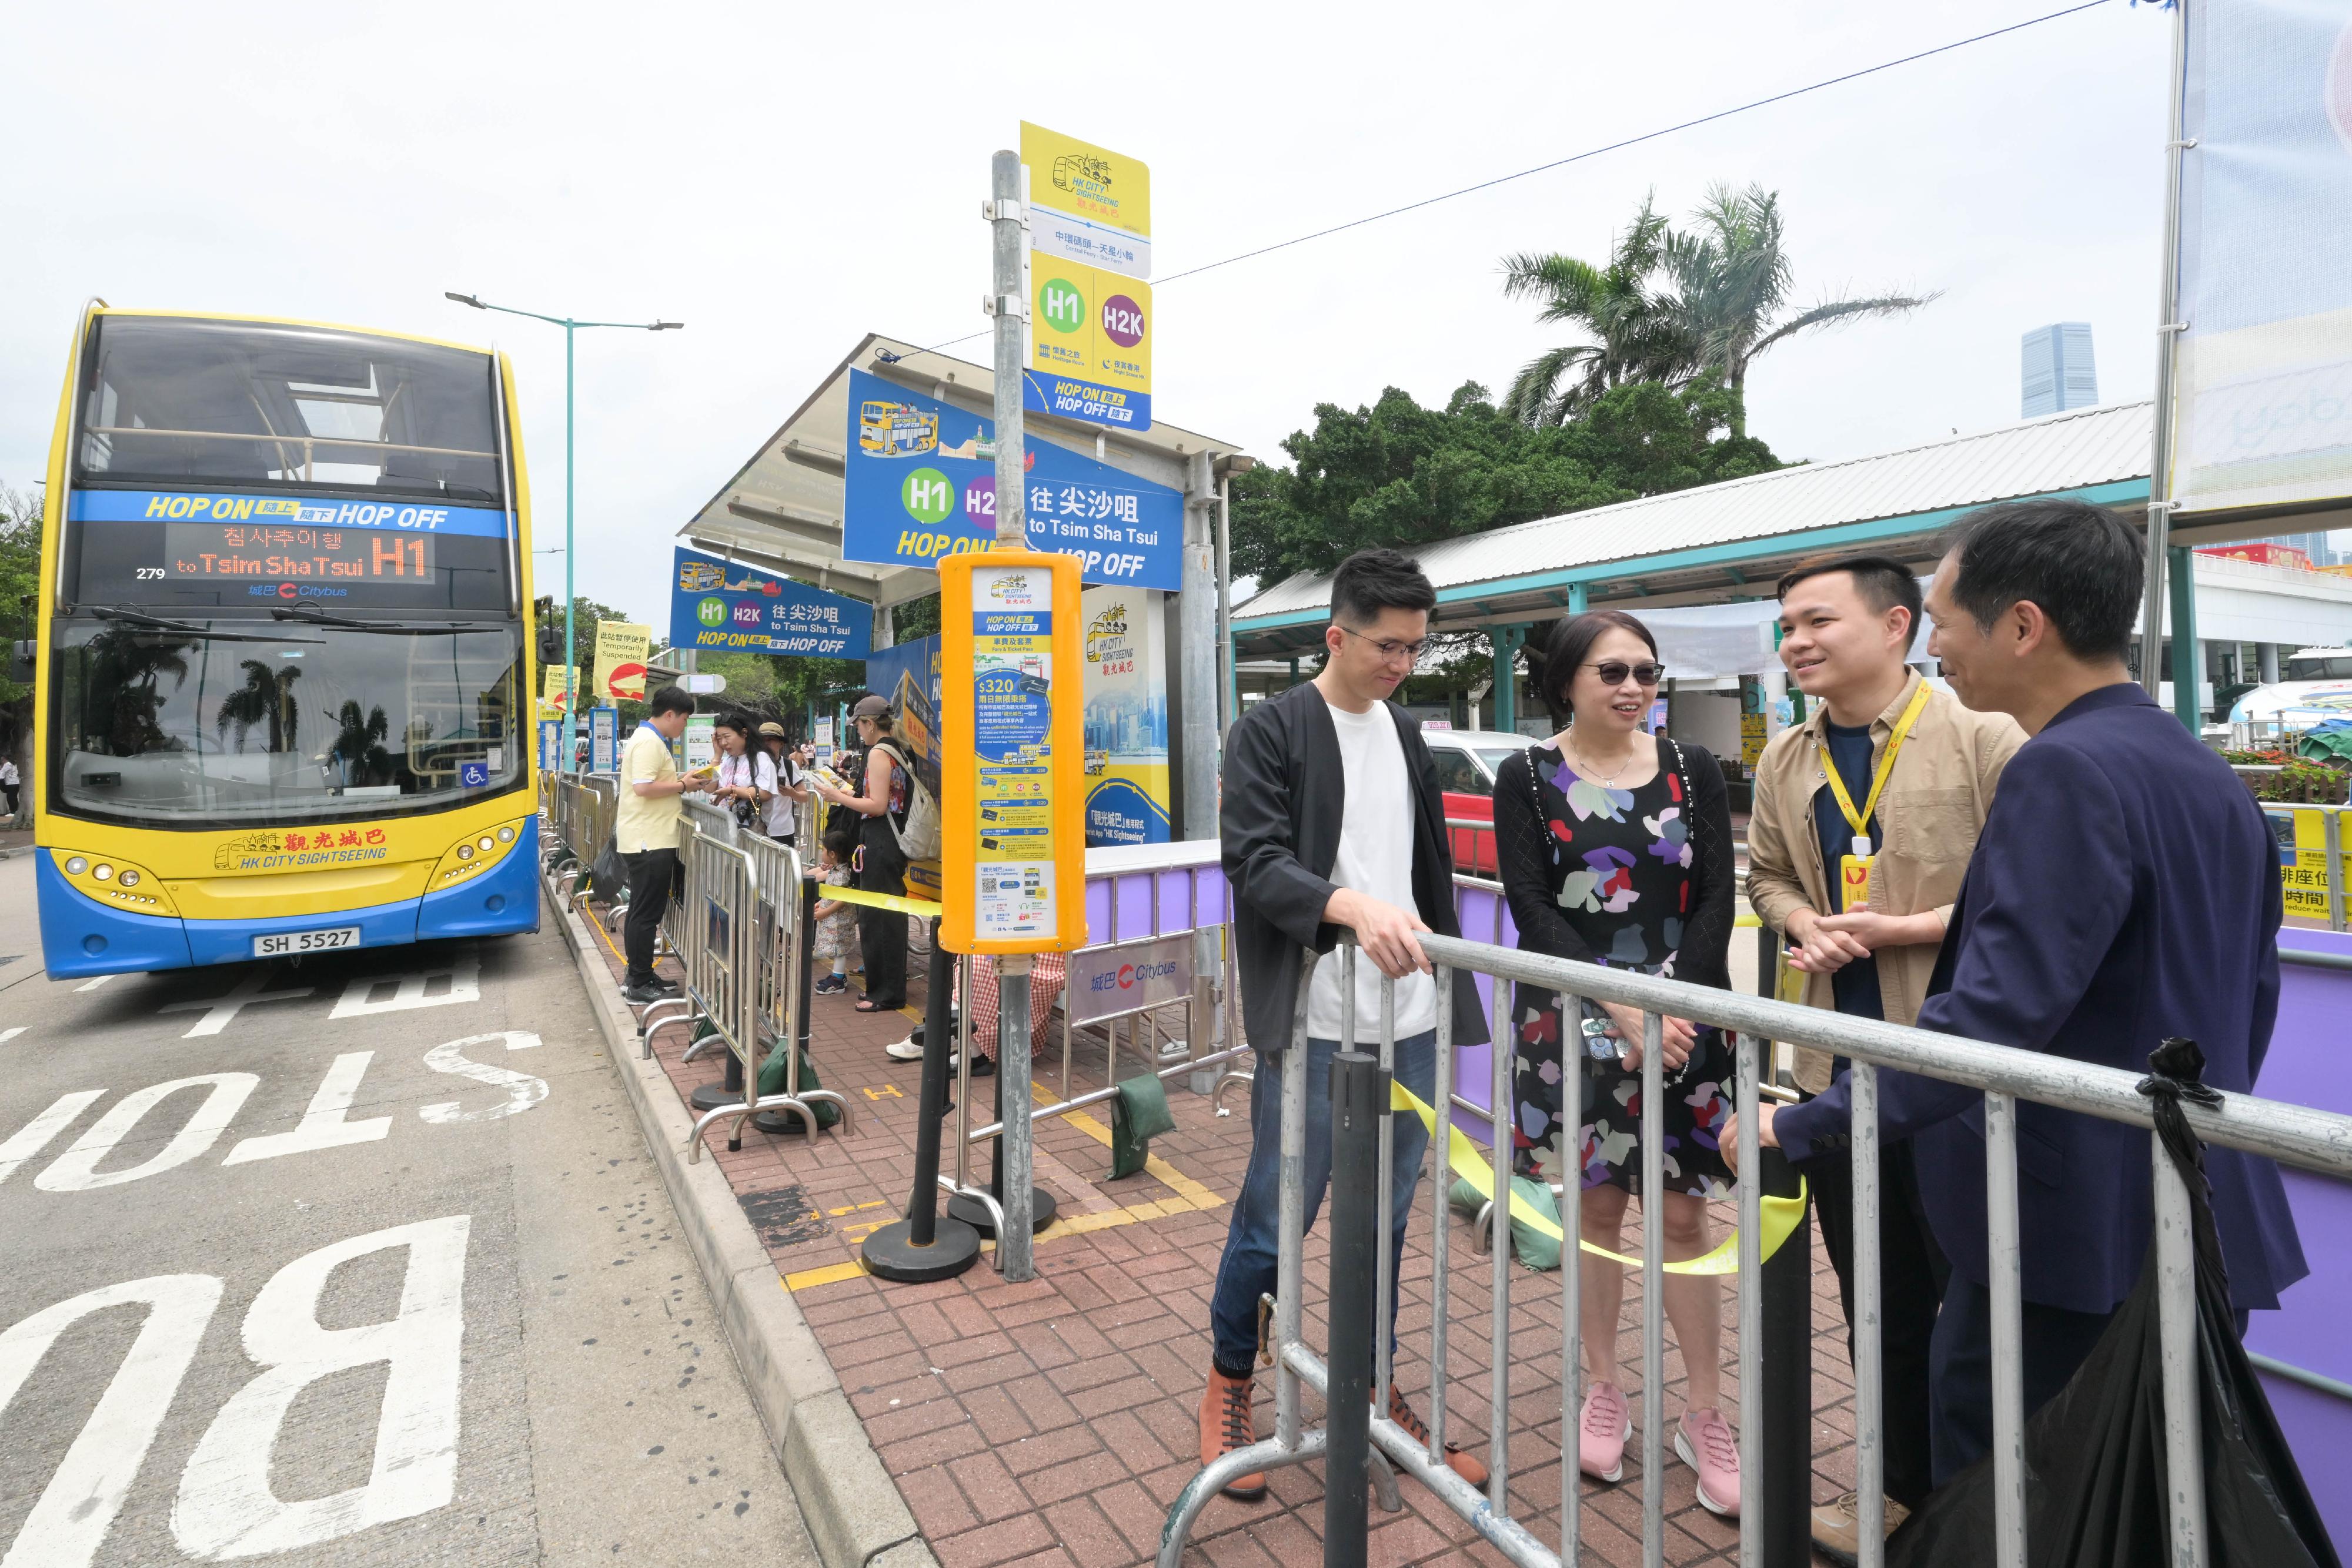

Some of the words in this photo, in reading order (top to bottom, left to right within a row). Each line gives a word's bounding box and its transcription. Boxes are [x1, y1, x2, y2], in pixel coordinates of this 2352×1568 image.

[1073, 177, 1085, 188] HK
[1085, 180, 1105, 193] CITY
[1076, 188, 1119, 208] SIGHTSEEING
[1065, 245, 1083, 254] Central
[1084, 249, 1096, 259] Ferry
[1110, 258, 1122, 266] Ferry
[1047, 287, 1078, 323] H1
[1104, 306, 1143, 337] H2K
[1053, 355, 1071, 363] Heritage
[1055, 381, 1081, 397] HOP
[1082, 387, 1100, 402] ON
[1055, 396, 1083, 412] HOP
[1084, 402, 1107, 416] OFF
[910, 478, 946, 511] H1
[966, 489, 995, 515] H2
[1031, 486, 1053, 513] 往
[1060, 487, 1139, 523] 尖沙咀
[145, 497, 211, 518] HOP
[212, 499, 255, 519] ON
[262, 502, 292, 514] 隨上
[299, 509, 331, 520] 隨下
[336, 504, 395, 526] HOP
[397, 508, 448, 529] OFF
[1030, 519, 1045, 533] to
[1050, 519, 1088, 538] Tsim
[1094, 524, 1122, 542] Sha
[1126, 529, 1158, 546] Tsui
[896, 530, 951, 558] HOP
[176, 559, 197, 573] to
[199, 554, 260, 574] Tsim
[266, 556, 310, 576] Sha
[313, 556, 363, 577] Tsui
[372, 537, 425, 577] H1
[1103, 553, 1145, 577] OFF
[136, 568, 165, 579] 279
[248, 584, 276, 596] 城巴
[299, 586, 347, 598] Citybus
[701, 603, 723, 621] H1
[734, 607, 760, 621] H2K
[773, 604, 786, 618] 往
[790, 604, 838, 623] 尖沙咀
[600, 631, 646, 644] 此站暫停使用
[771, 621, 780, 630] to
[784, 622, 807, 632] Tsim
[810, 624, 828, 634] Sha
[830, 625, 851, 635] Tsui
[602, 641, 643, 652] Temporarily
[696, 631, 728, 645] HOP
[728, 633, 749, 647] ON
[788, 637, 818, 651] HOP
[818, 640, 846, 653] OFF
[1100, 639, 1108, 651] HK
[1108, 636, 1122, 650] CITY
[602, 651, 641, 660] Suspended
[1102, 648, 1133, 662] SIGHTSEEING
[979, 679, 1014, 693] $320
[283, 828, 386, 851] 觀光城巴
[240, 857, 259, 869] HK
[263, 855, 296, 867] CITY
[298, 847, 386, 865] SIGHTSEEING
[263, 938, 289, 953] SH
[299, 931, 352, 950] 5527
[1091, 972, 1115, 992] 城巴
[1135, 961, 1176, 981] Citybus
[0, 1215, 470, 1568] BU
